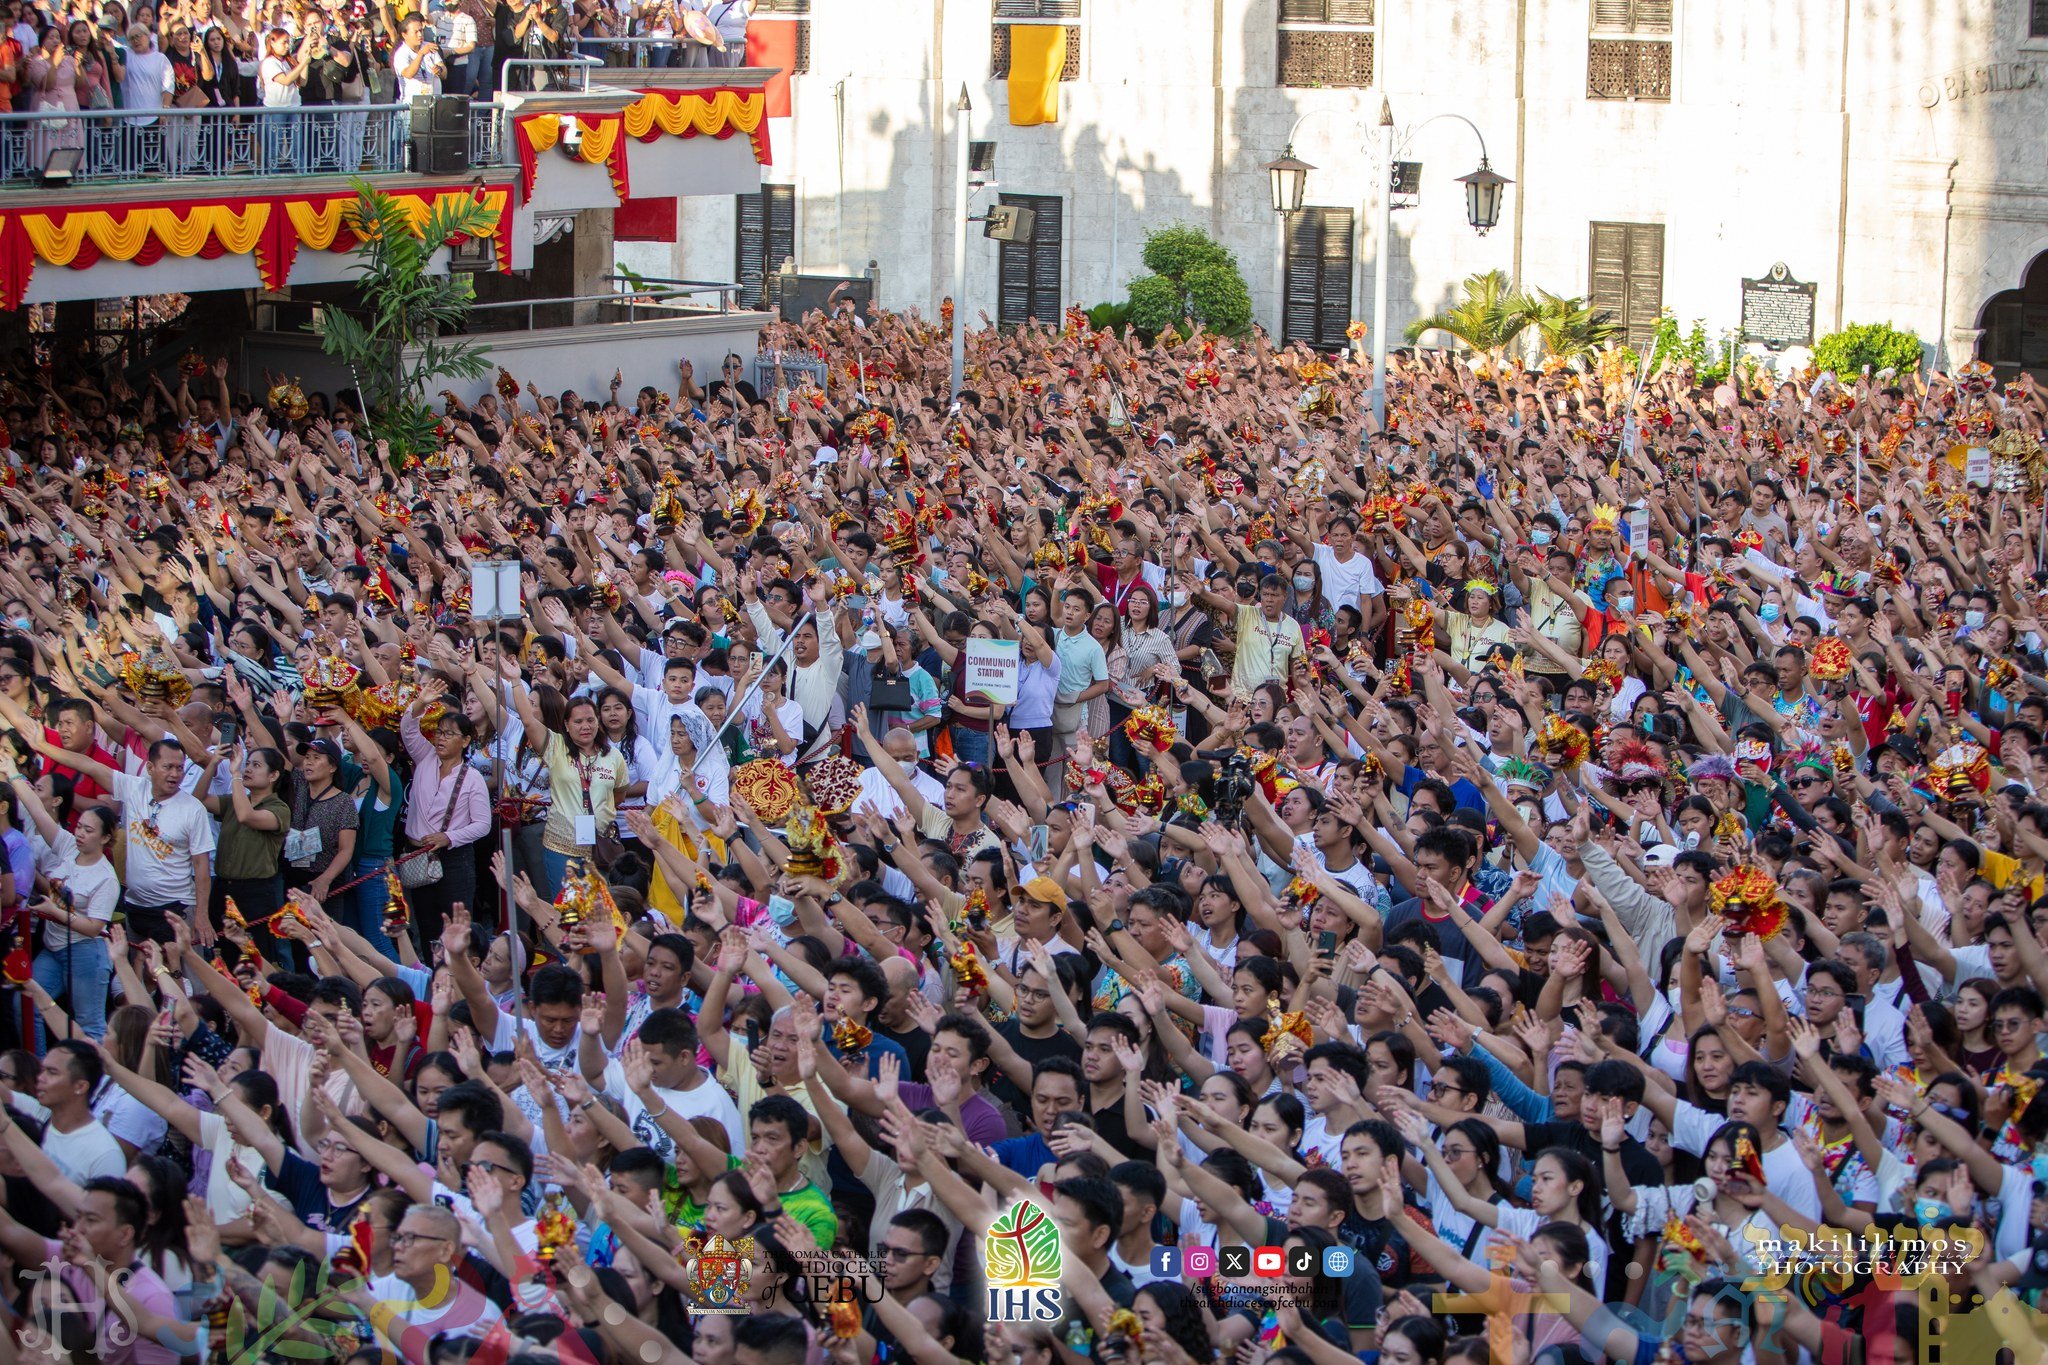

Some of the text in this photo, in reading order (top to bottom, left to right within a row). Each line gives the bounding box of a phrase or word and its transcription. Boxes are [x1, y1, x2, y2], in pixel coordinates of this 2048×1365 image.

[1943, 61, 2043, 101] BASILICA
[967, 656, 1016, 668] COMMUNION
[977, 668, 1004, 678] STATION
